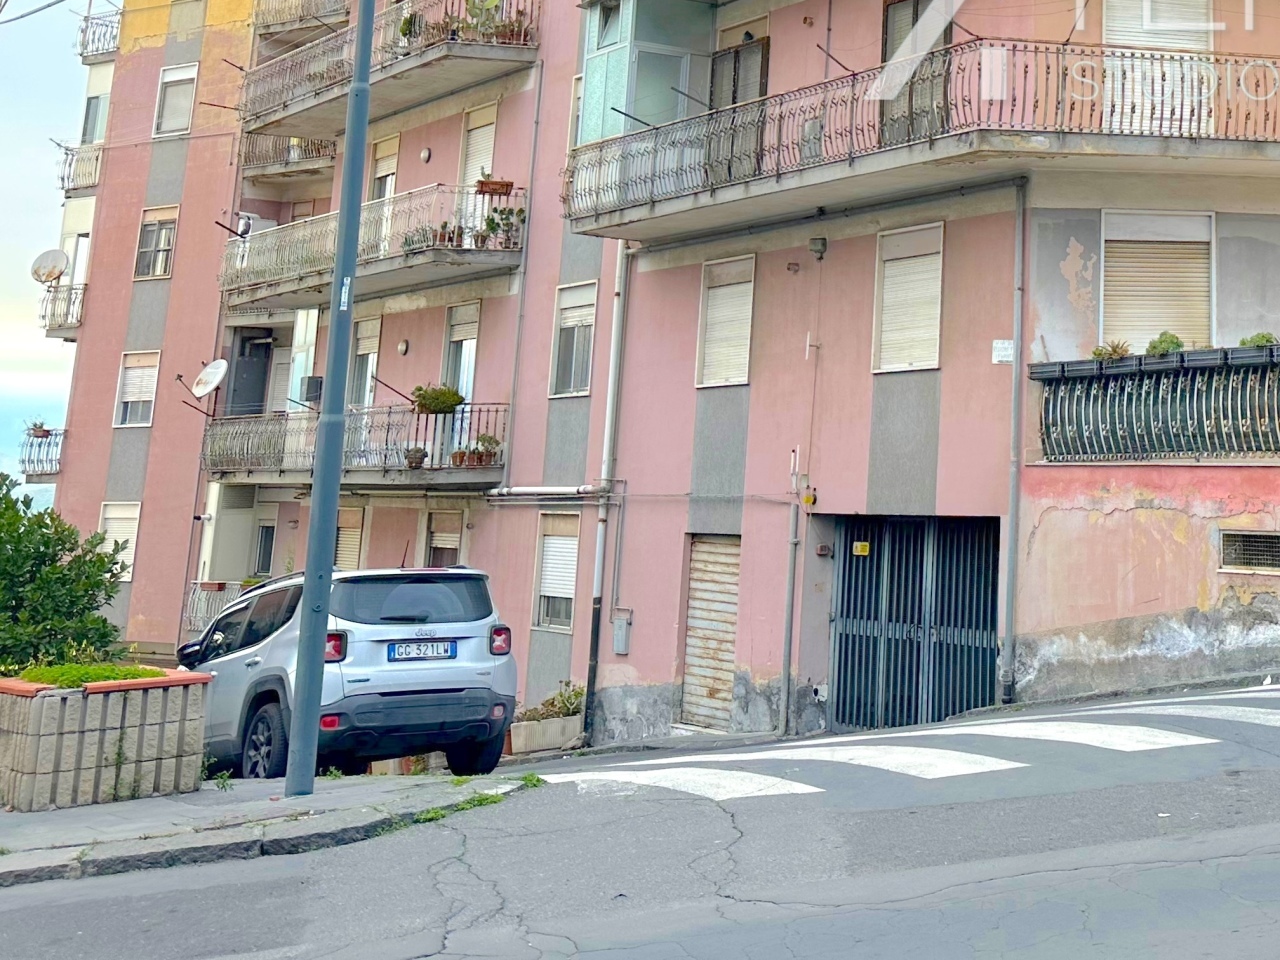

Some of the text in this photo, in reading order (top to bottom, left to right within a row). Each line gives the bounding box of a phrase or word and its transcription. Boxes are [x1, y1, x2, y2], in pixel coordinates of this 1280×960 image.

[415, 627, 437, 639] Jeep
[397, 644, 410, 656] GG
[415, 642, 449, 656] 321LW
